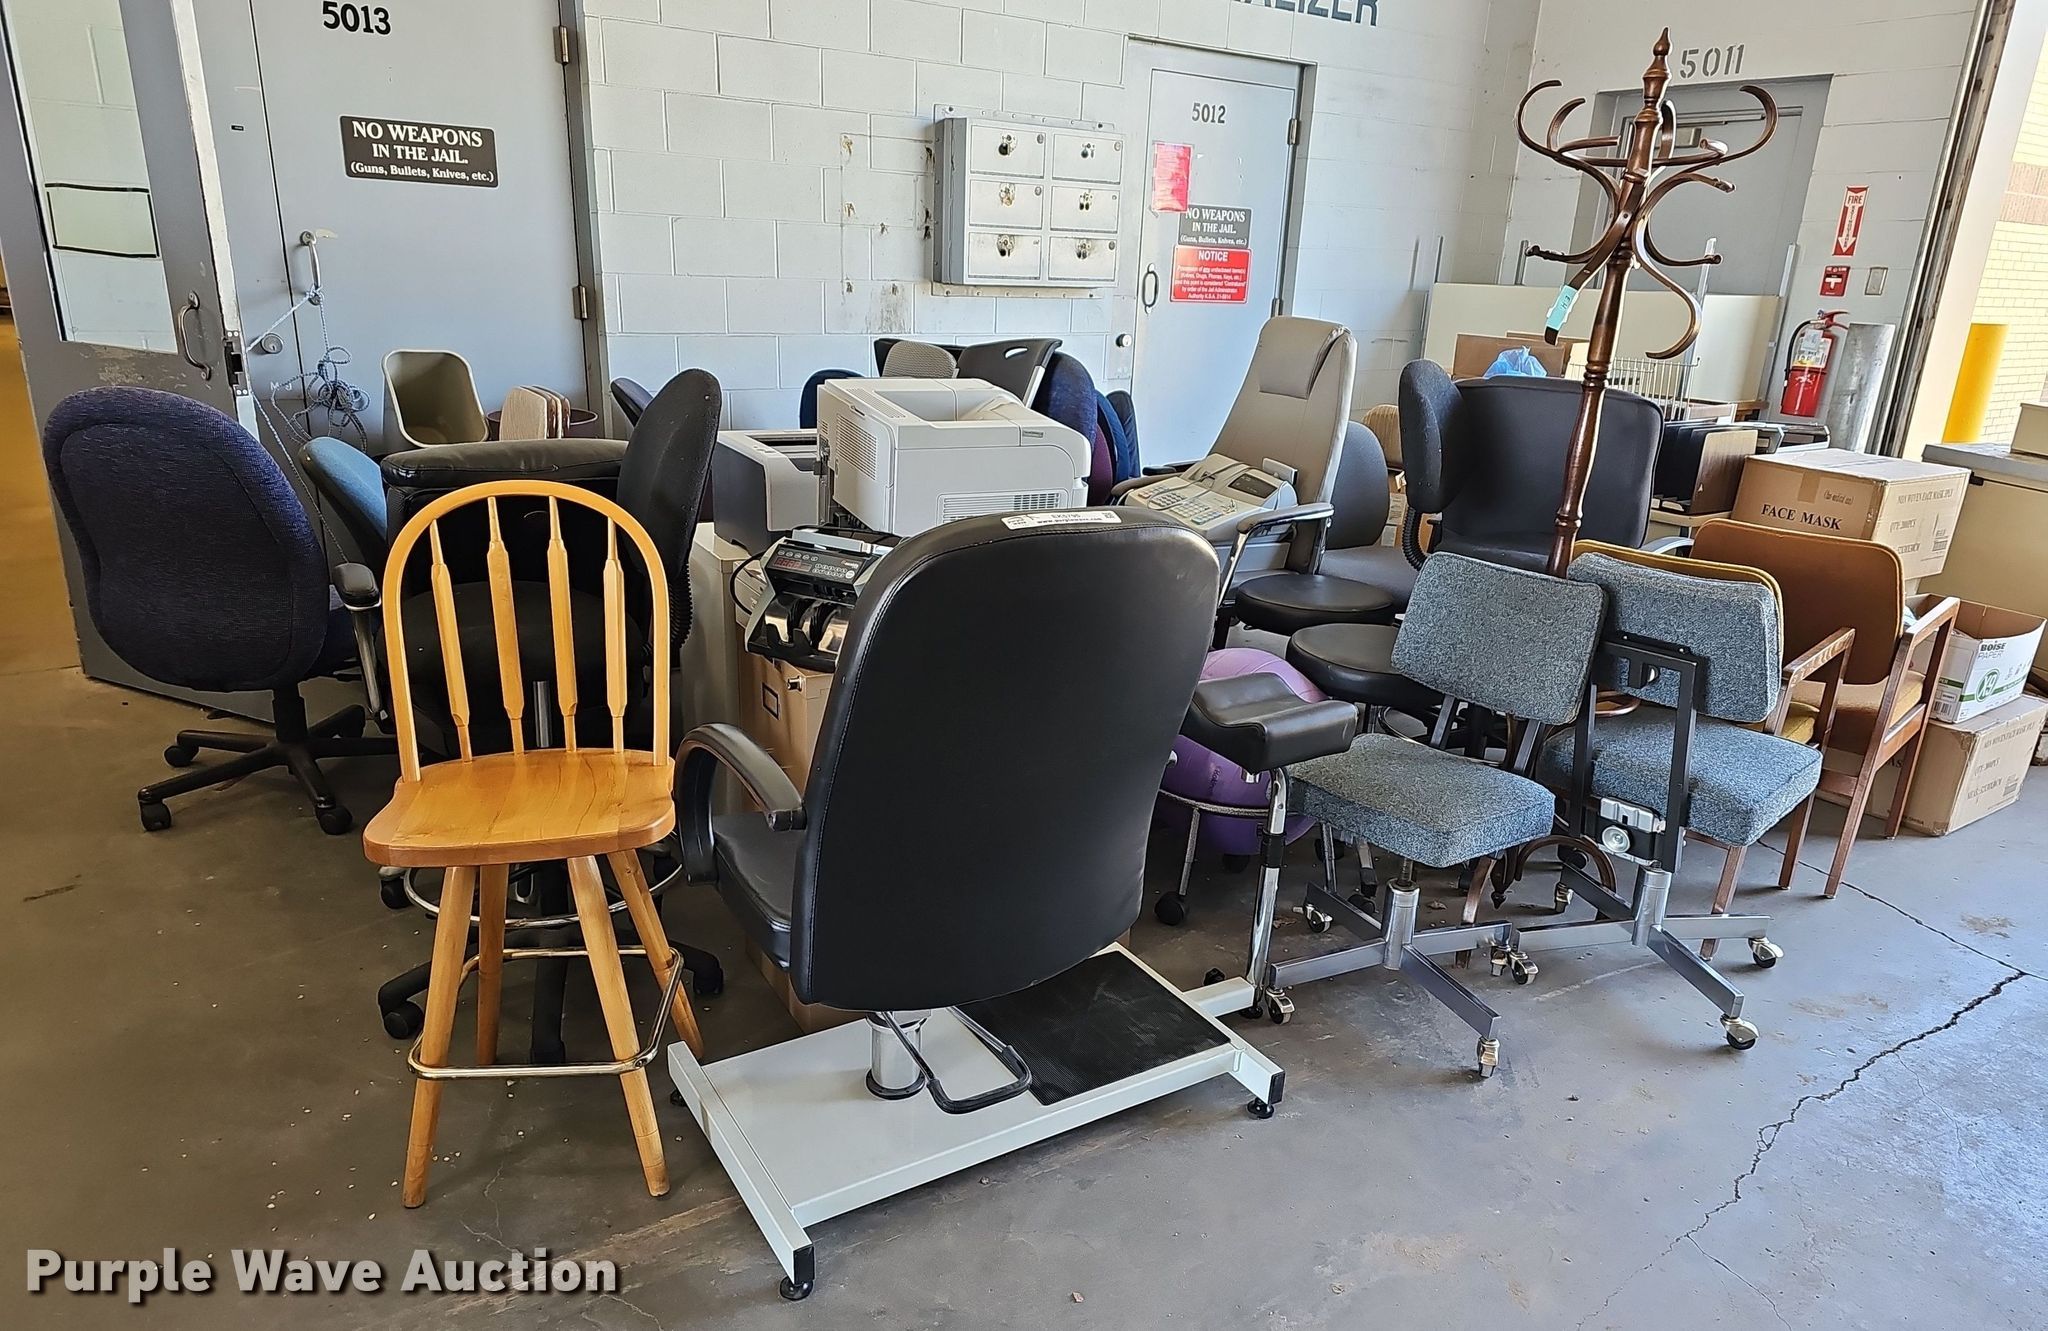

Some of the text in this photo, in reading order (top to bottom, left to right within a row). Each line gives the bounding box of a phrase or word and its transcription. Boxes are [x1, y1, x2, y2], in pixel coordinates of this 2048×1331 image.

[322, 0, 391, 35] 5013
[1680, 44, 1745, 79] 5011
[1191, 102, 1226, 124] 5012
[351, 120, 483, 148] NO WEAPONS
[371, 143, 469, 165] IN THE JAIL.
[350, 161, 495, 183] (Guns, Bullets, Knives, etc.)
[1847, 195, 1863, 205] FIRE
[1185, 207, 1246, 223] NO WEAPONS
[1192, 221, 1237, 234] IN THE JAIL.
[1198, 250, 1229, 262] NOTICE
[1760, 503, 1843, 531] FACE MASK
[1977, 651, 2003, 660] PAPER
[1980, 641, 2007, 652] BOISE
